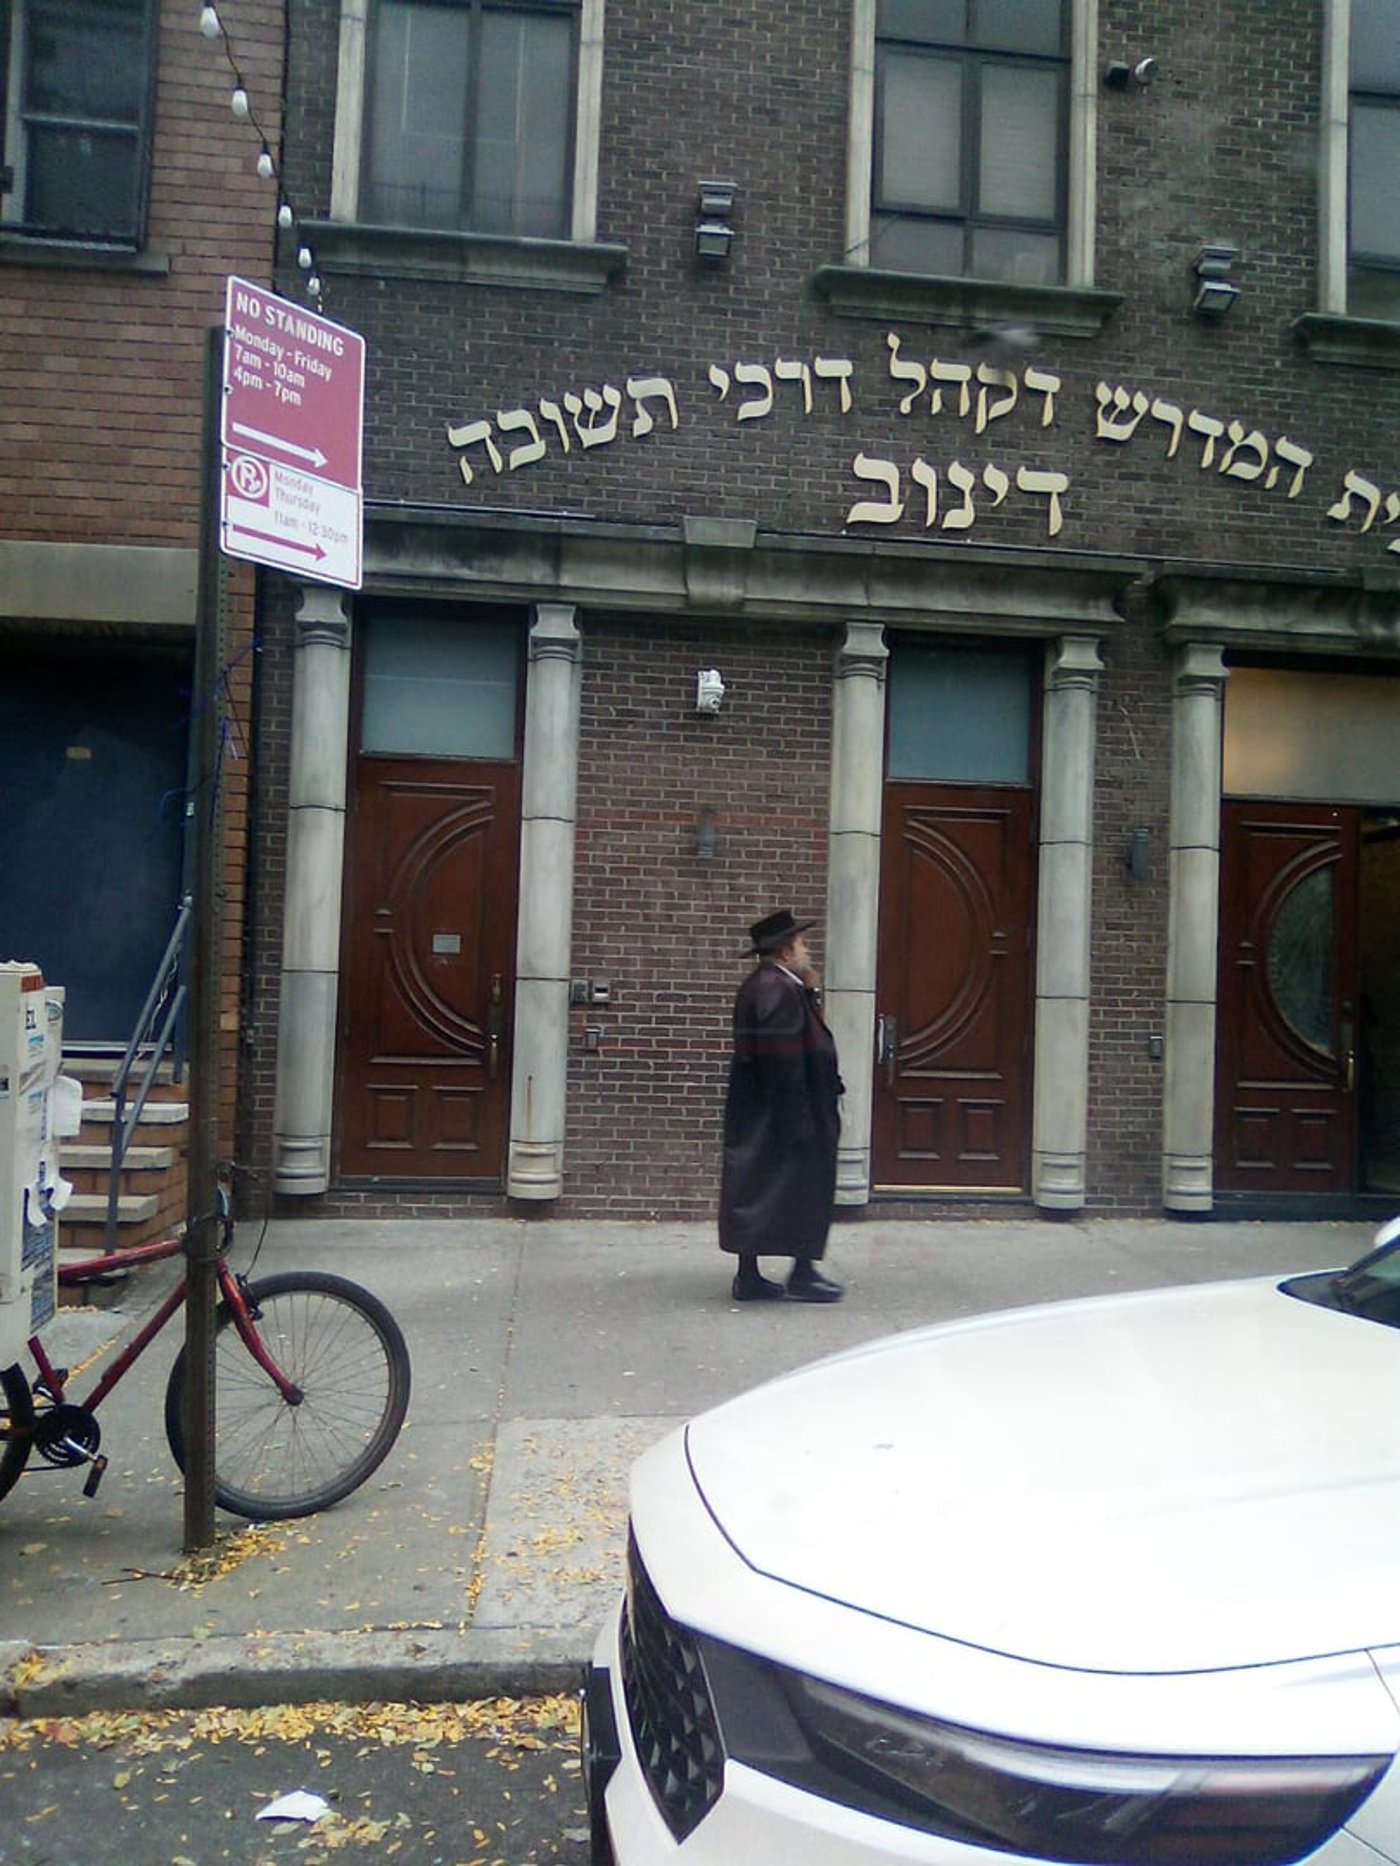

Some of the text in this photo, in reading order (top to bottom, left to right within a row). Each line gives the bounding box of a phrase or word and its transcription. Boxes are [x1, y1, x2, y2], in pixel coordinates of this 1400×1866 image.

[235, 323, 284, 361] Monday
[295, 349, 332, 382] Friday
[236, 291, 344, 356] NO STANDING
[234, 342, 261, 369] 7am
[273, 361, 305, 387] 10am
[234, 366, 263, 390] 4pm
[274, 380, 301, 406] 7pm
[708, 356, 853, 421] דרכי
[887, 332, 1061, 434] דקהל
[448, 377, 678, 485] תשובה
[1096, 381, 1313, 499] המדרש
[274, 470, 313, 495] Monday
[276, 486, 320, 514] Thursday
[846, 452, 1069, 536] דינוב
[274, 511, 299, 529] 11am
